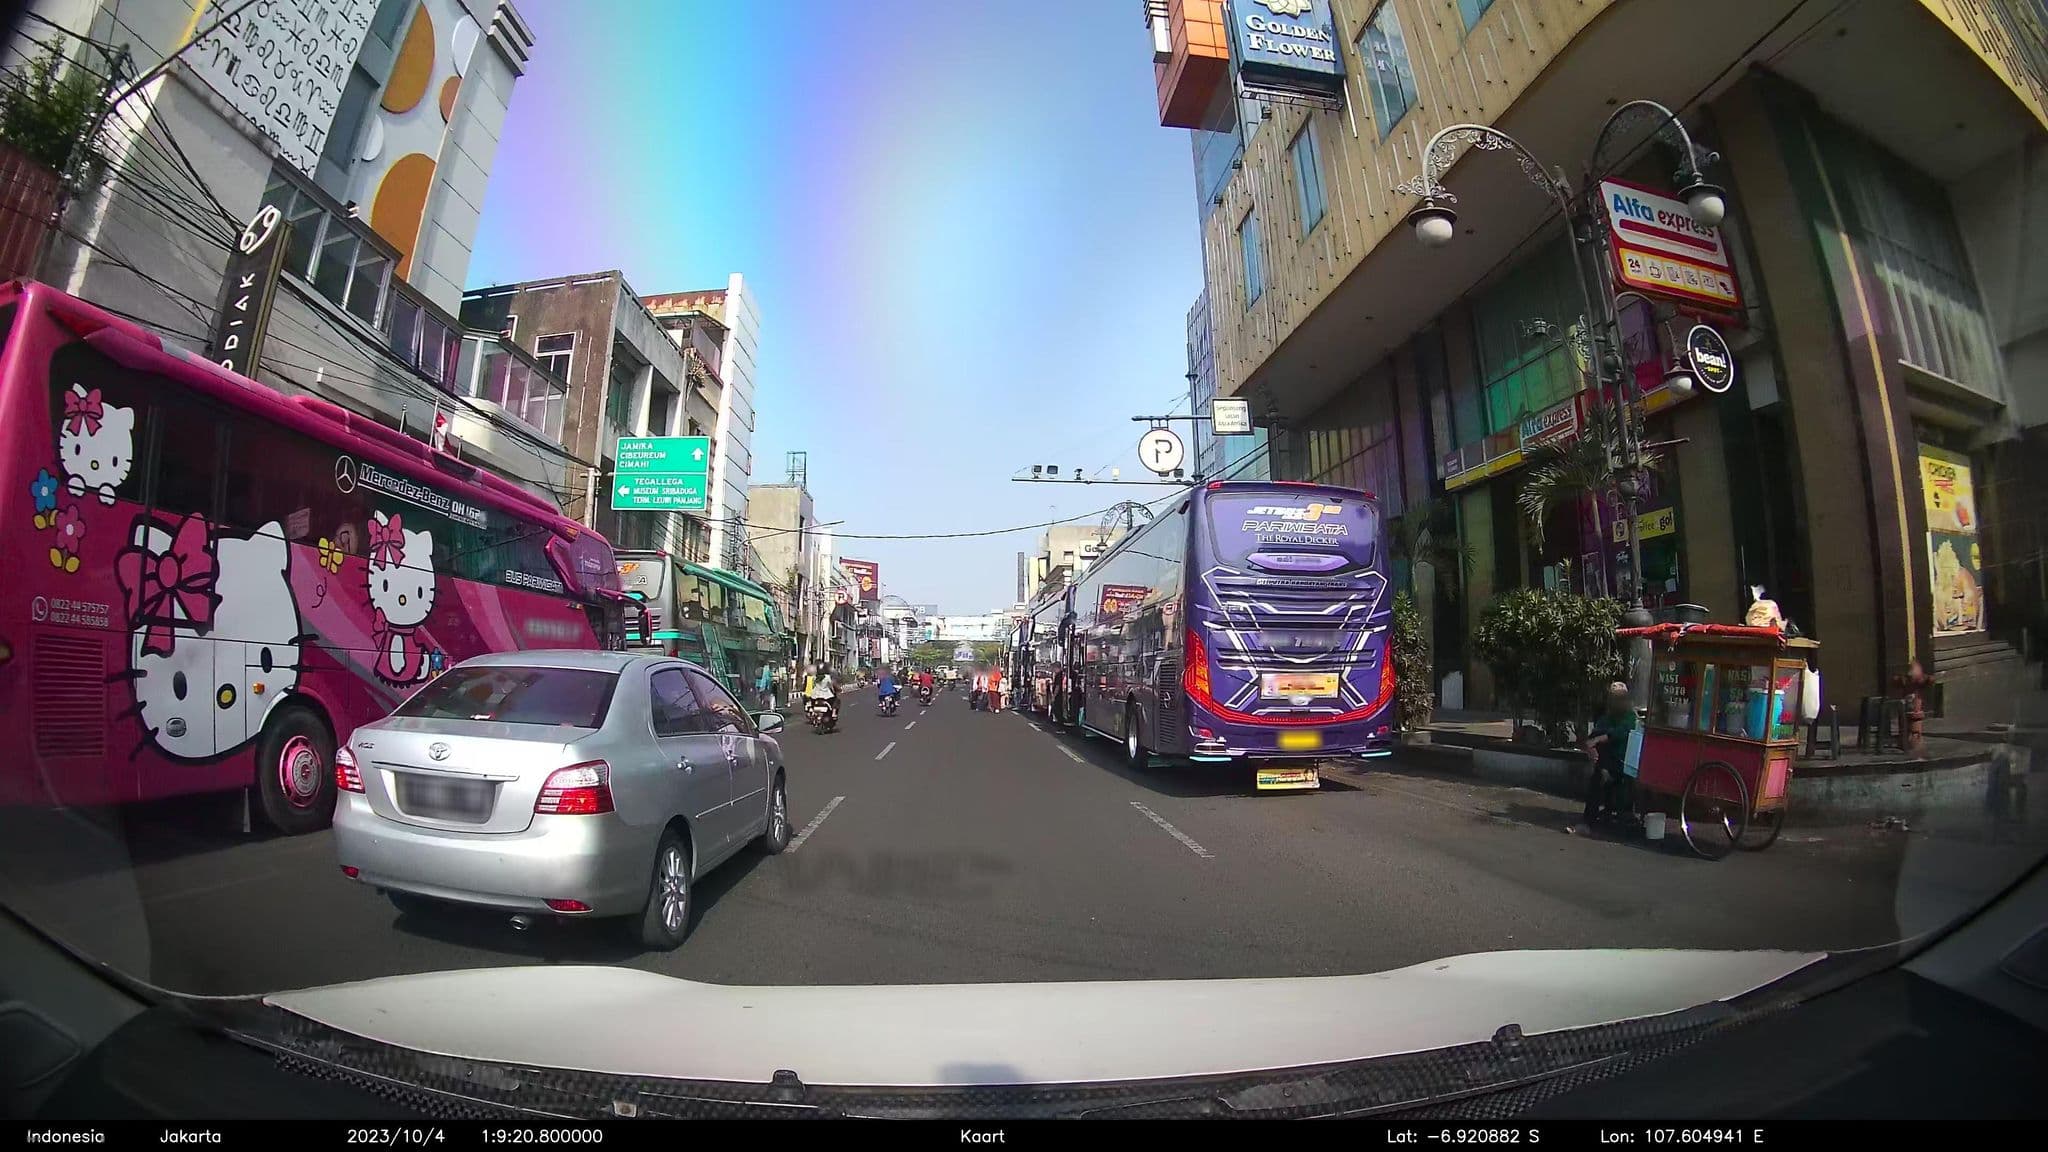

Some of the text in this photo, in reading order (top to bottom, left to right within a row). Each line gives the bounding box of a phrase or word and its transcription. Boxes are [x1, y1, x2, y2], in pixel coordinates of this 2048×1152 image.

[1245, 14, 1330, 42] GOLDEN
[1247, 33, 1336, 62] FLOWER
[1613, 193, 1655, 222] Alfa
[220, 272, 256, 371] ODIAK
[619, 451, 667, 459] CIBEUREUM
[620, 442, 653, 450] JAMIKA
[634, 478, 684, 486] TEGALLEGA
[1242, 520, 1348, 535] PARIWISATA
